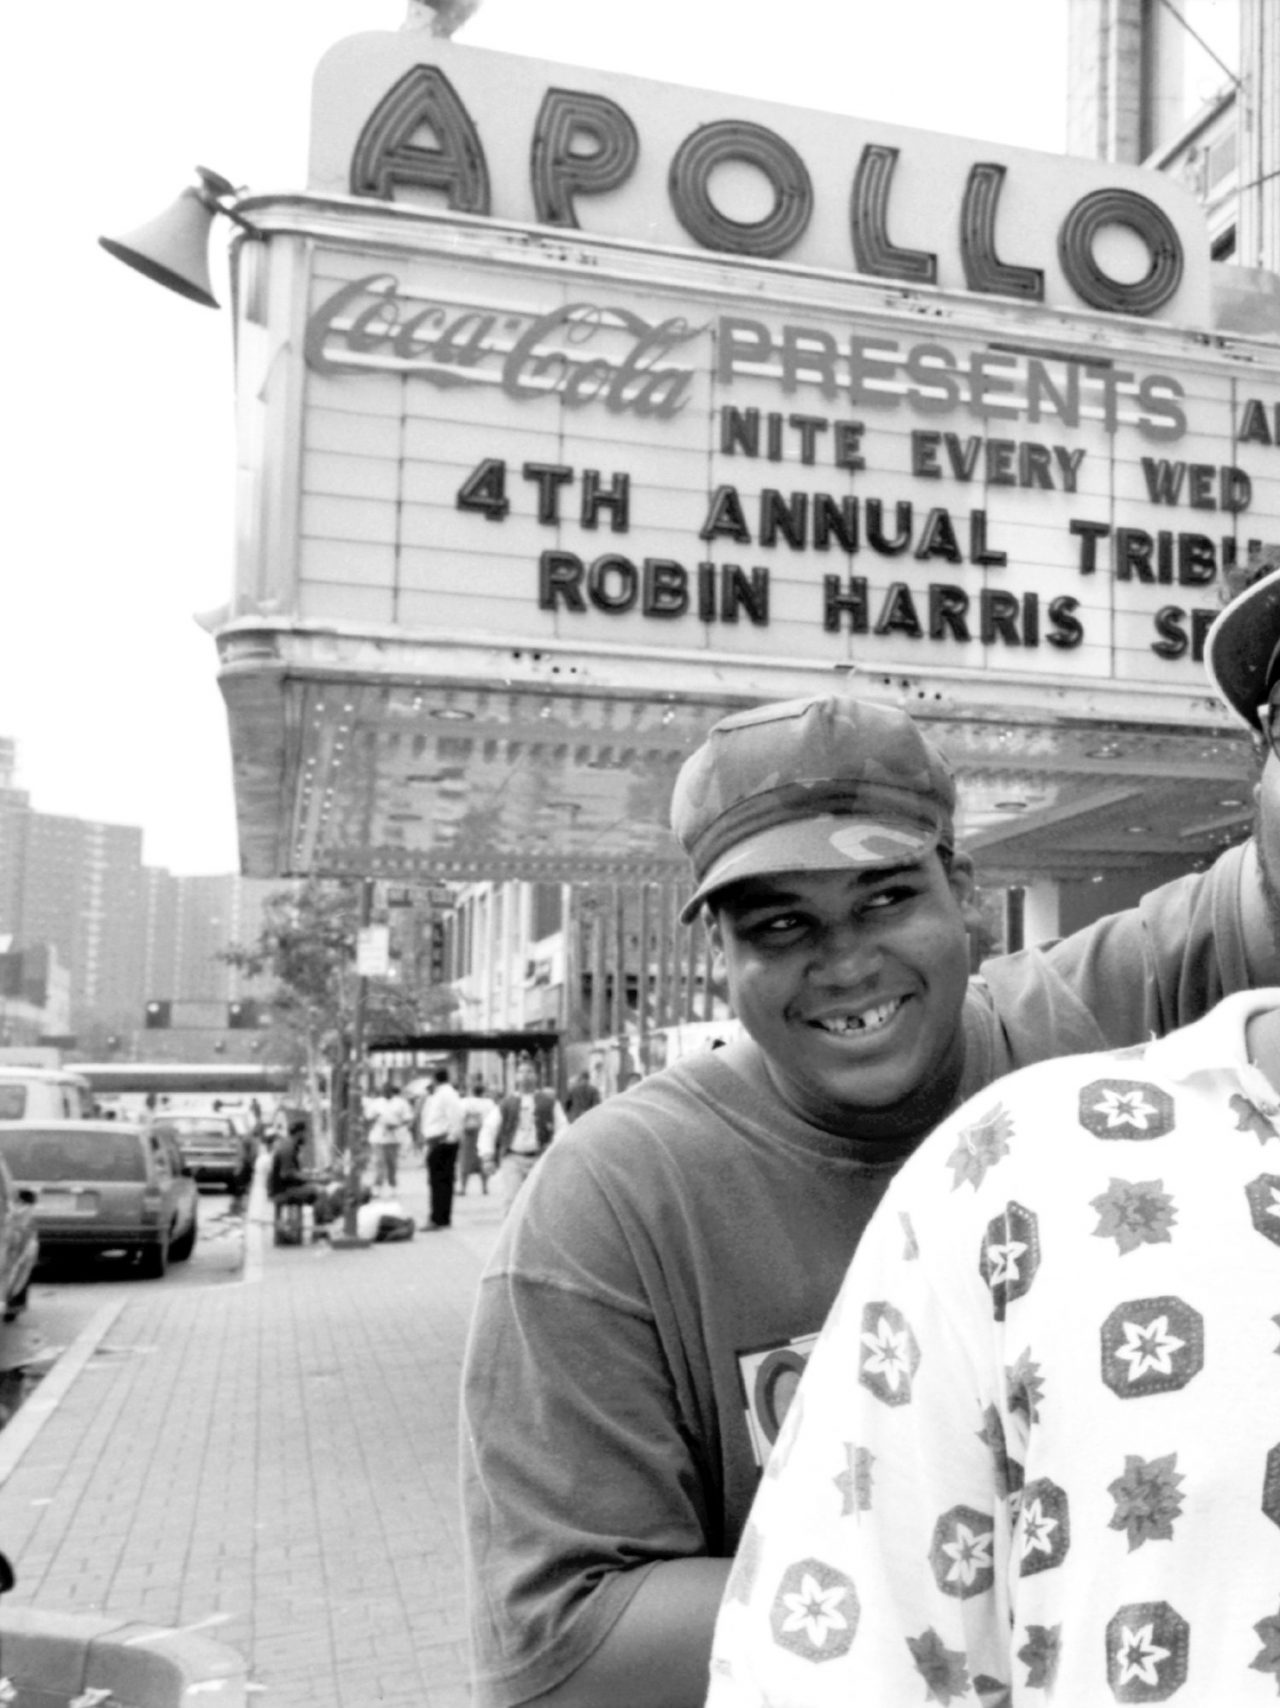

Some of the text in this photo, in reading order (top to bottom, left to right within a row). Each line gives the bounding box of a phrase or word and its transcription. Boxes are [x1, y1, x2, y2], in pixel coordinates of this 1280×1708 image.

[350, 63, 1184, 317] APOLLO
[304, 272, 708, 420] Coca-Cola
[717, 316, 1188, 443] PRESENTS
[456, 458, 631, 533] 4TH
[699, 484, 1008, 568] ANNUAL
[720, 404, 1254, 514] NITE EVERY WED
[537, 550, 771, 626] ROBIN
[822, 573, 1085, 651] HARRIS
